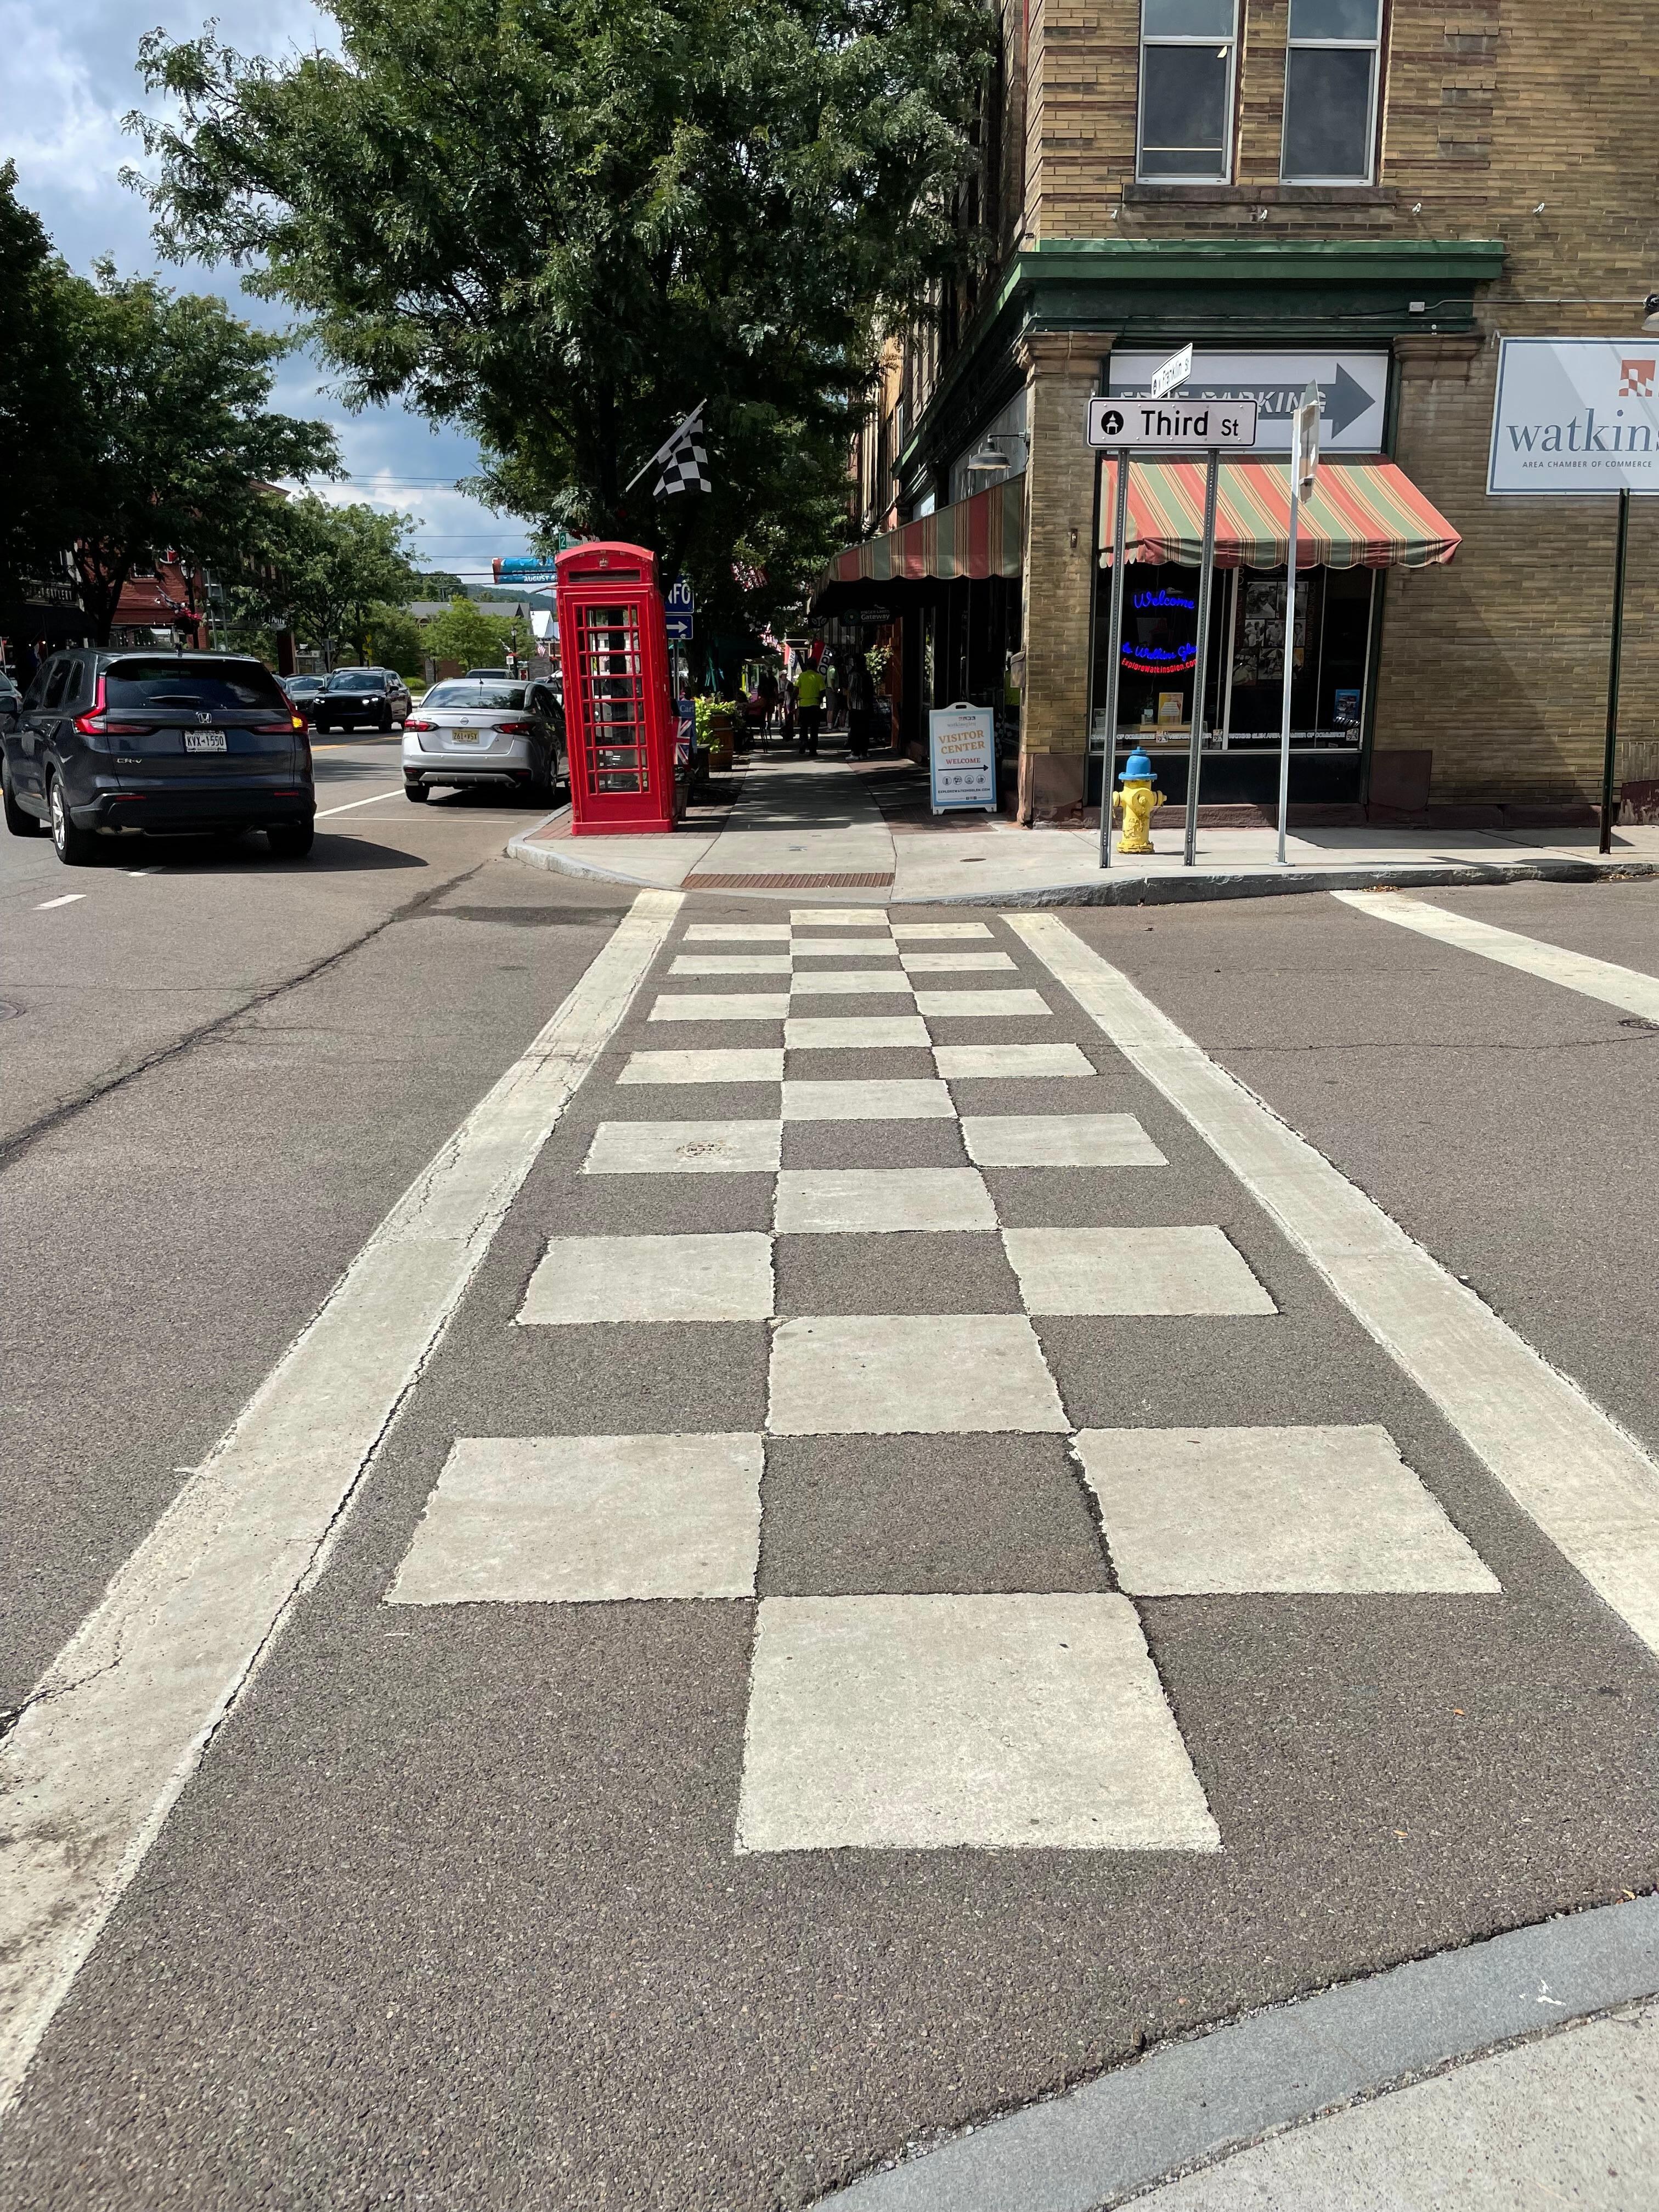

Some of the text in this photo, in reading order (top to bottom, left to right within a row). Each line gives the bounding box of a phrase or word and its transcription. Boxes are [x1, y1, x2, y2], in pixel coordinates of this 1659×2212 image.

[1141, 410, 1239, 436] Third St
[1506, 408, 1659, 452] watkin
[1134, 590, 1195, 609] Welcome
[939, 730, 984, 743] VISITOR
[941, 741, 985, 754] CENTER
